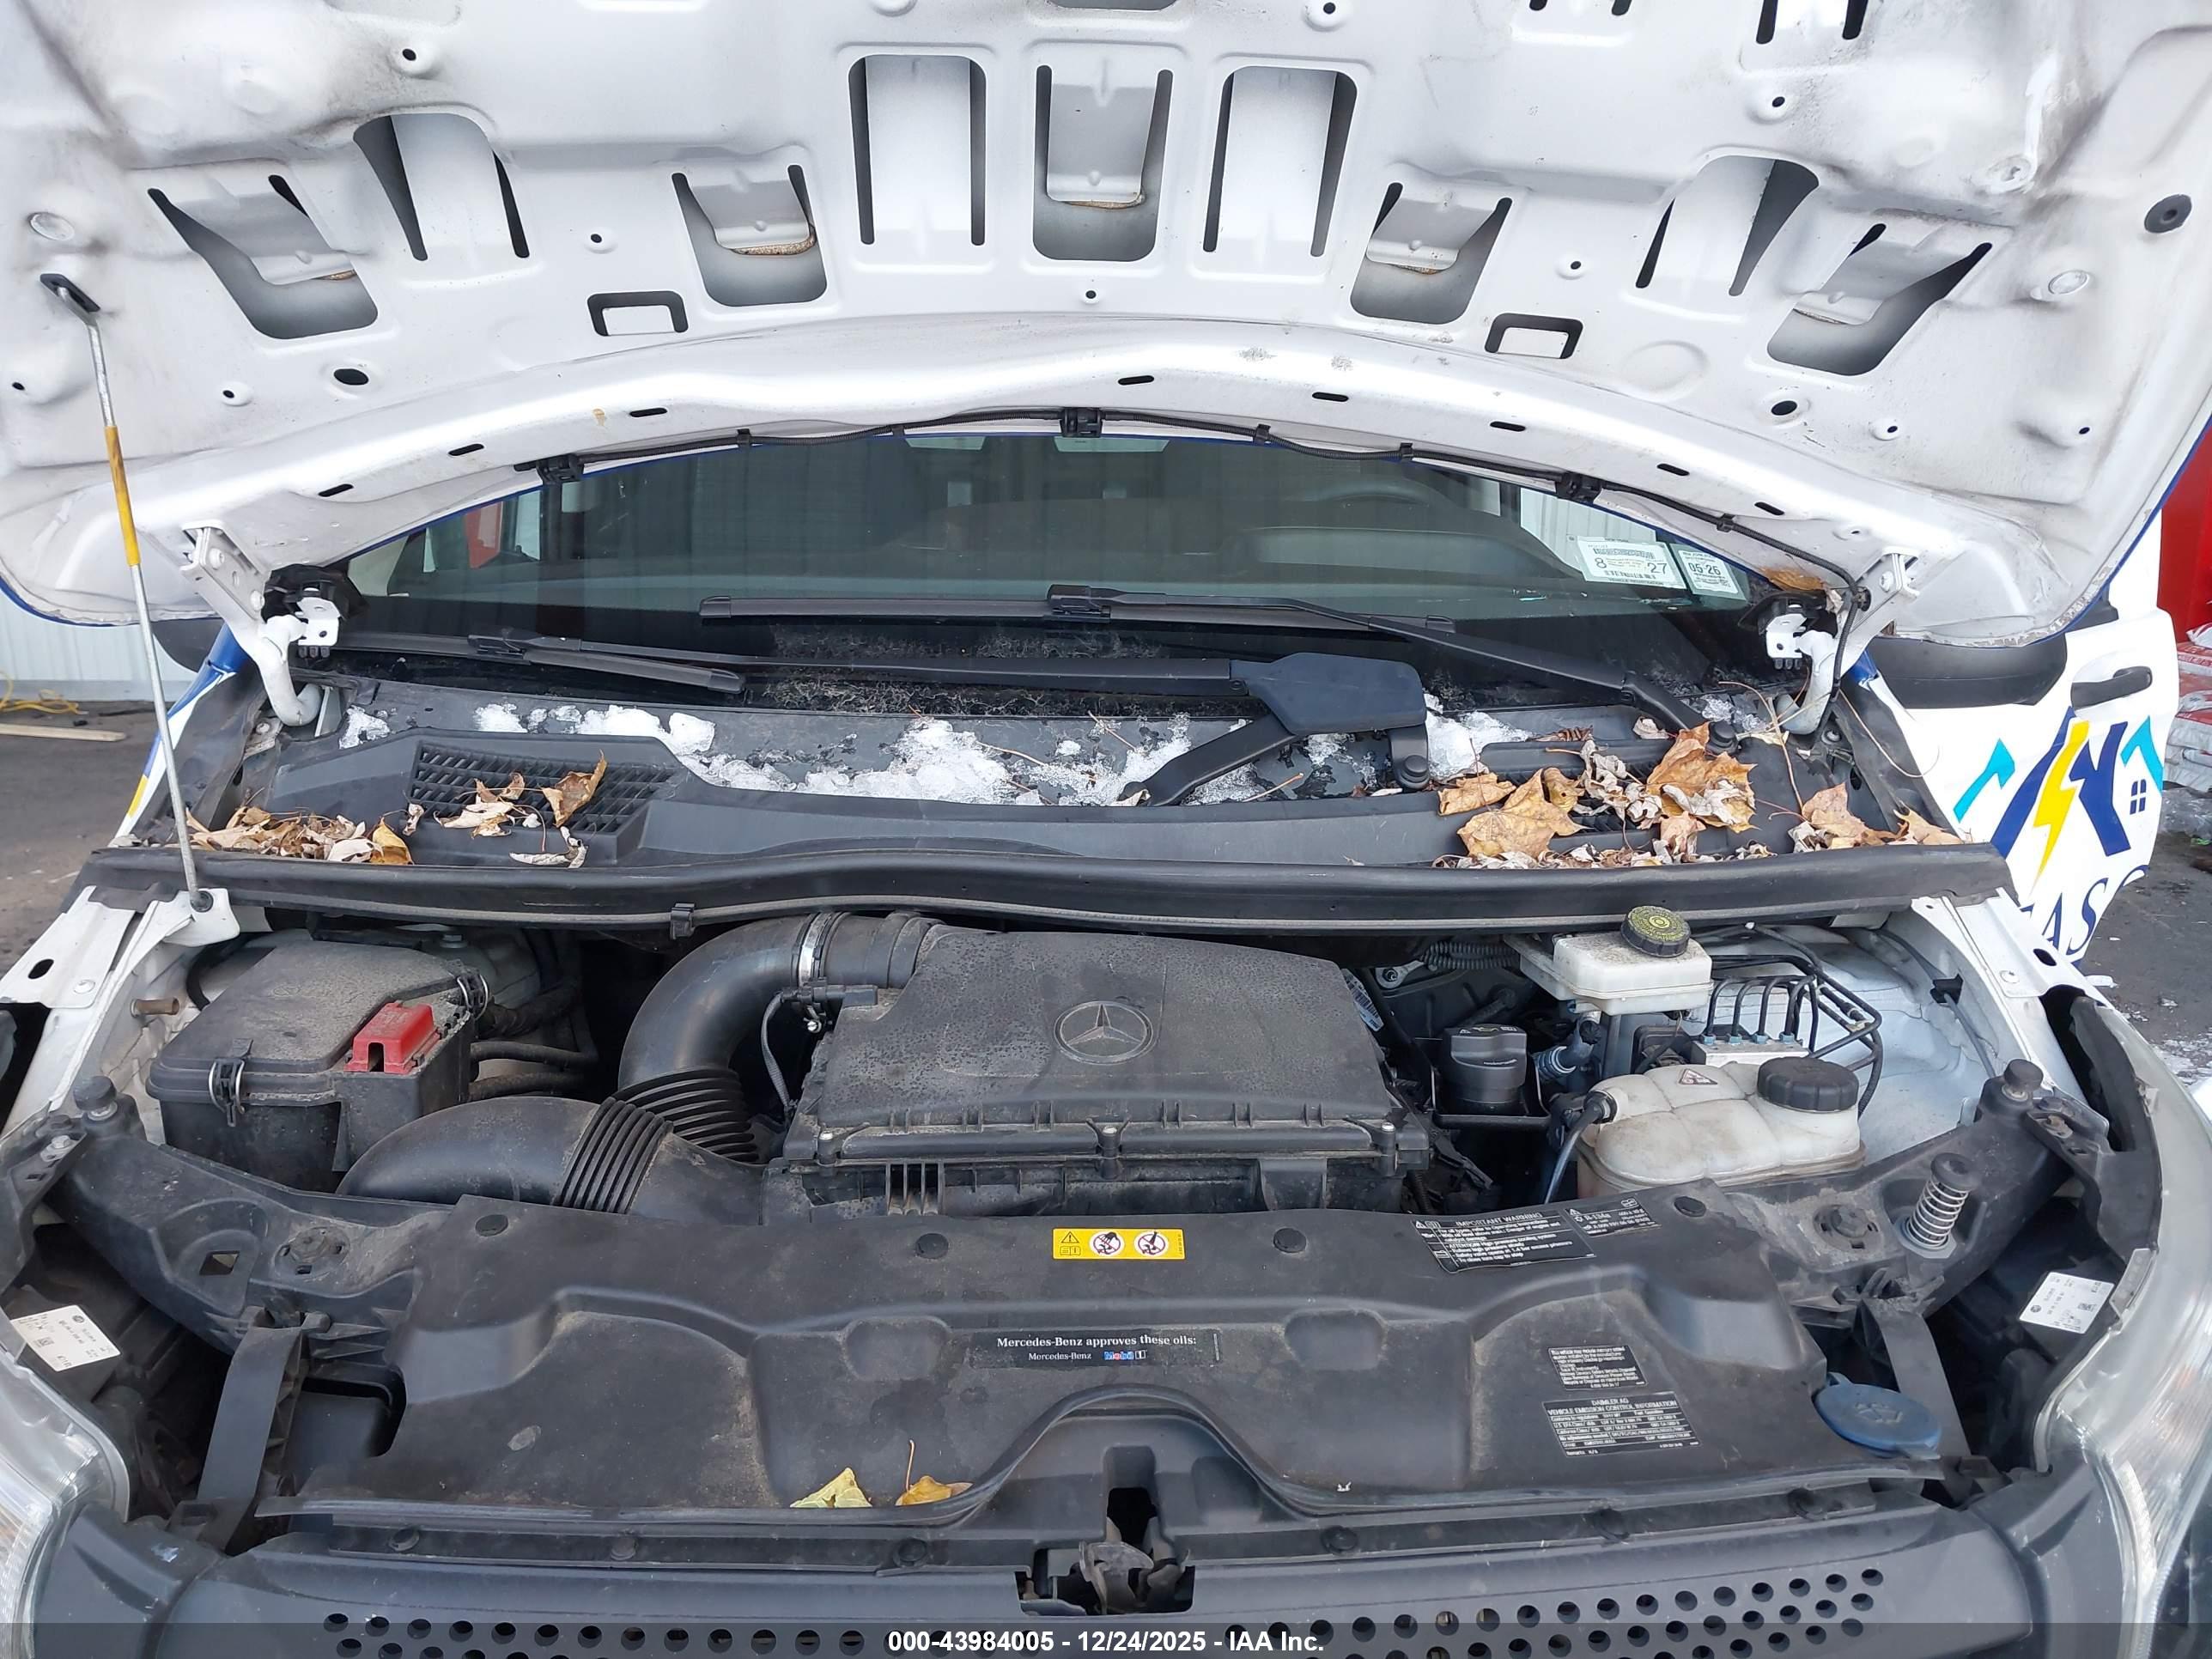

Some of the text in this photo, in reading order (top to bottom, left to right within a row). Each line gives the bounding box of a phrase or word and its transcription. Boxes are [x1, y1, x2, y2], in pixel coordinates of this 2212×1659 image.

[1595, 557, 1607, 568] 8
[1647, 562, 1668, 574] 27
[1688, 562, 1721, 575] 05-26
[1455, 1212, 1543, 1228] IMPORTANT WARNING
[997, 1334, 1196, 1348] Mercedes-Benz approves these oils:
[1103, 1352, 1134, 1360] Mobil
[1636, 1401, 1677, 1409] INFORMATION
